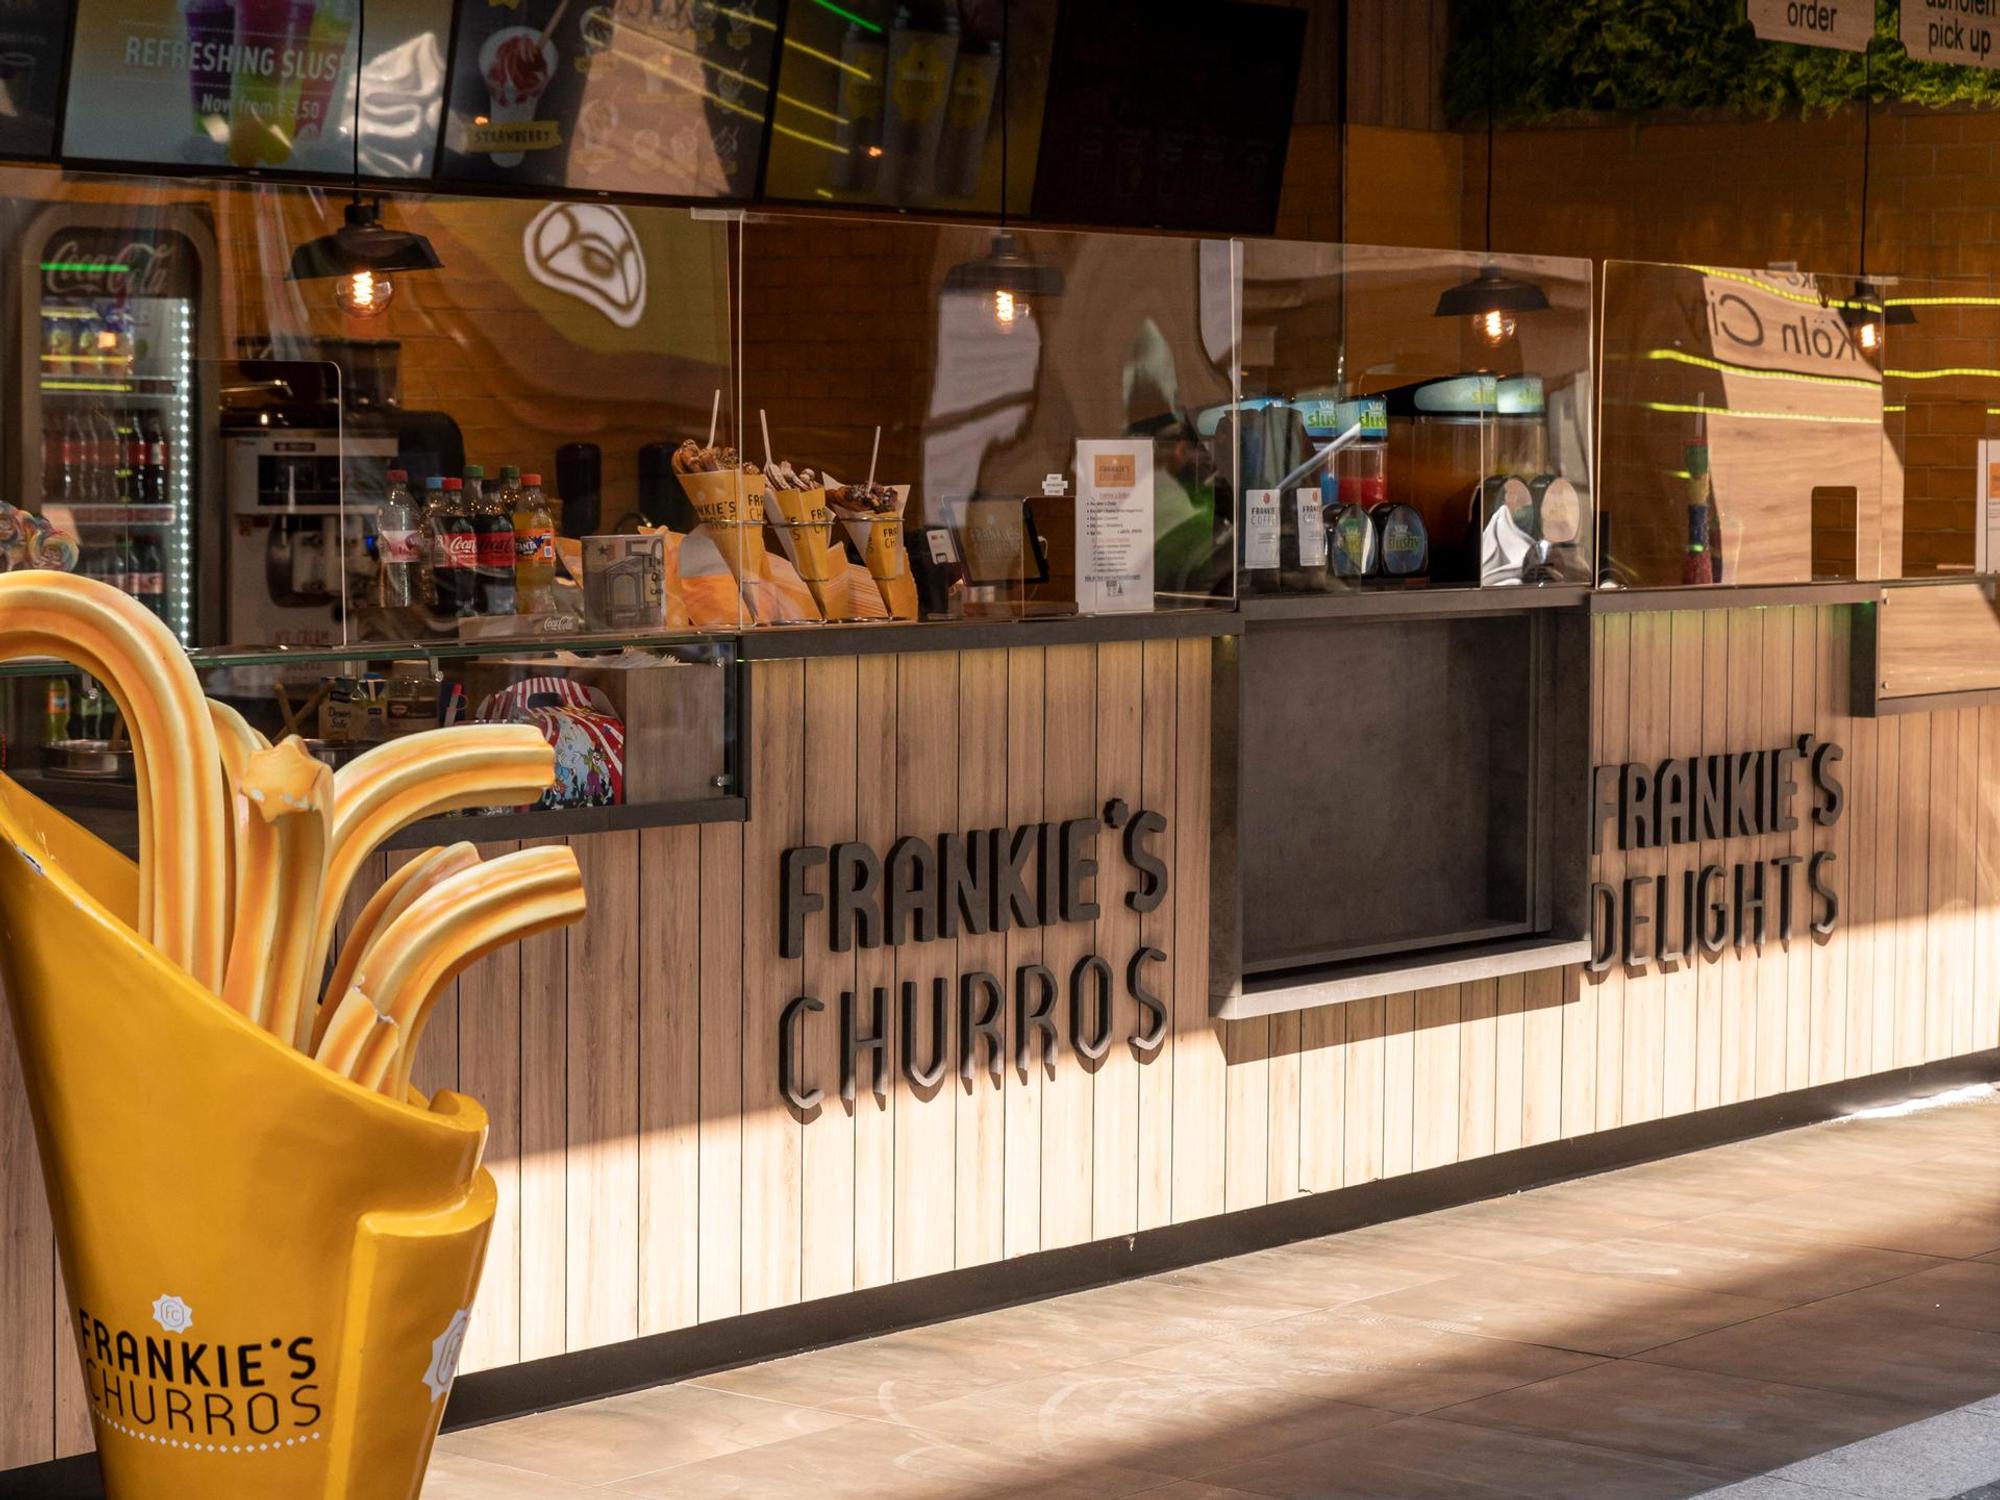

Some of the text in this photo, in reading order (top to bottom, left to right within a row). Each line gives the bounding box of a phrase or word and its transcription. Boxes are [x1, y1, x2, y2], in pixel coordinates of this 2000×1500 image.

[124, 36, 275, 77] REFRESHING
[1787, 1, 1838, 32] order
[1929, 16, 1991, 61] pick up
[202, 93, 232, 115] Now
[1593, 734, 1843, 856] FRANKIE'S
[779, 799, 1168, 959] FRANKIE'S
[1585, 851, 1839, 972] DELIGHTS
[779, 947, 1168, 1110] CHURROS
[79, 1306, 317, 1389] FRANKIE'S
[86, 1356, 322, 1437] CHURROS
